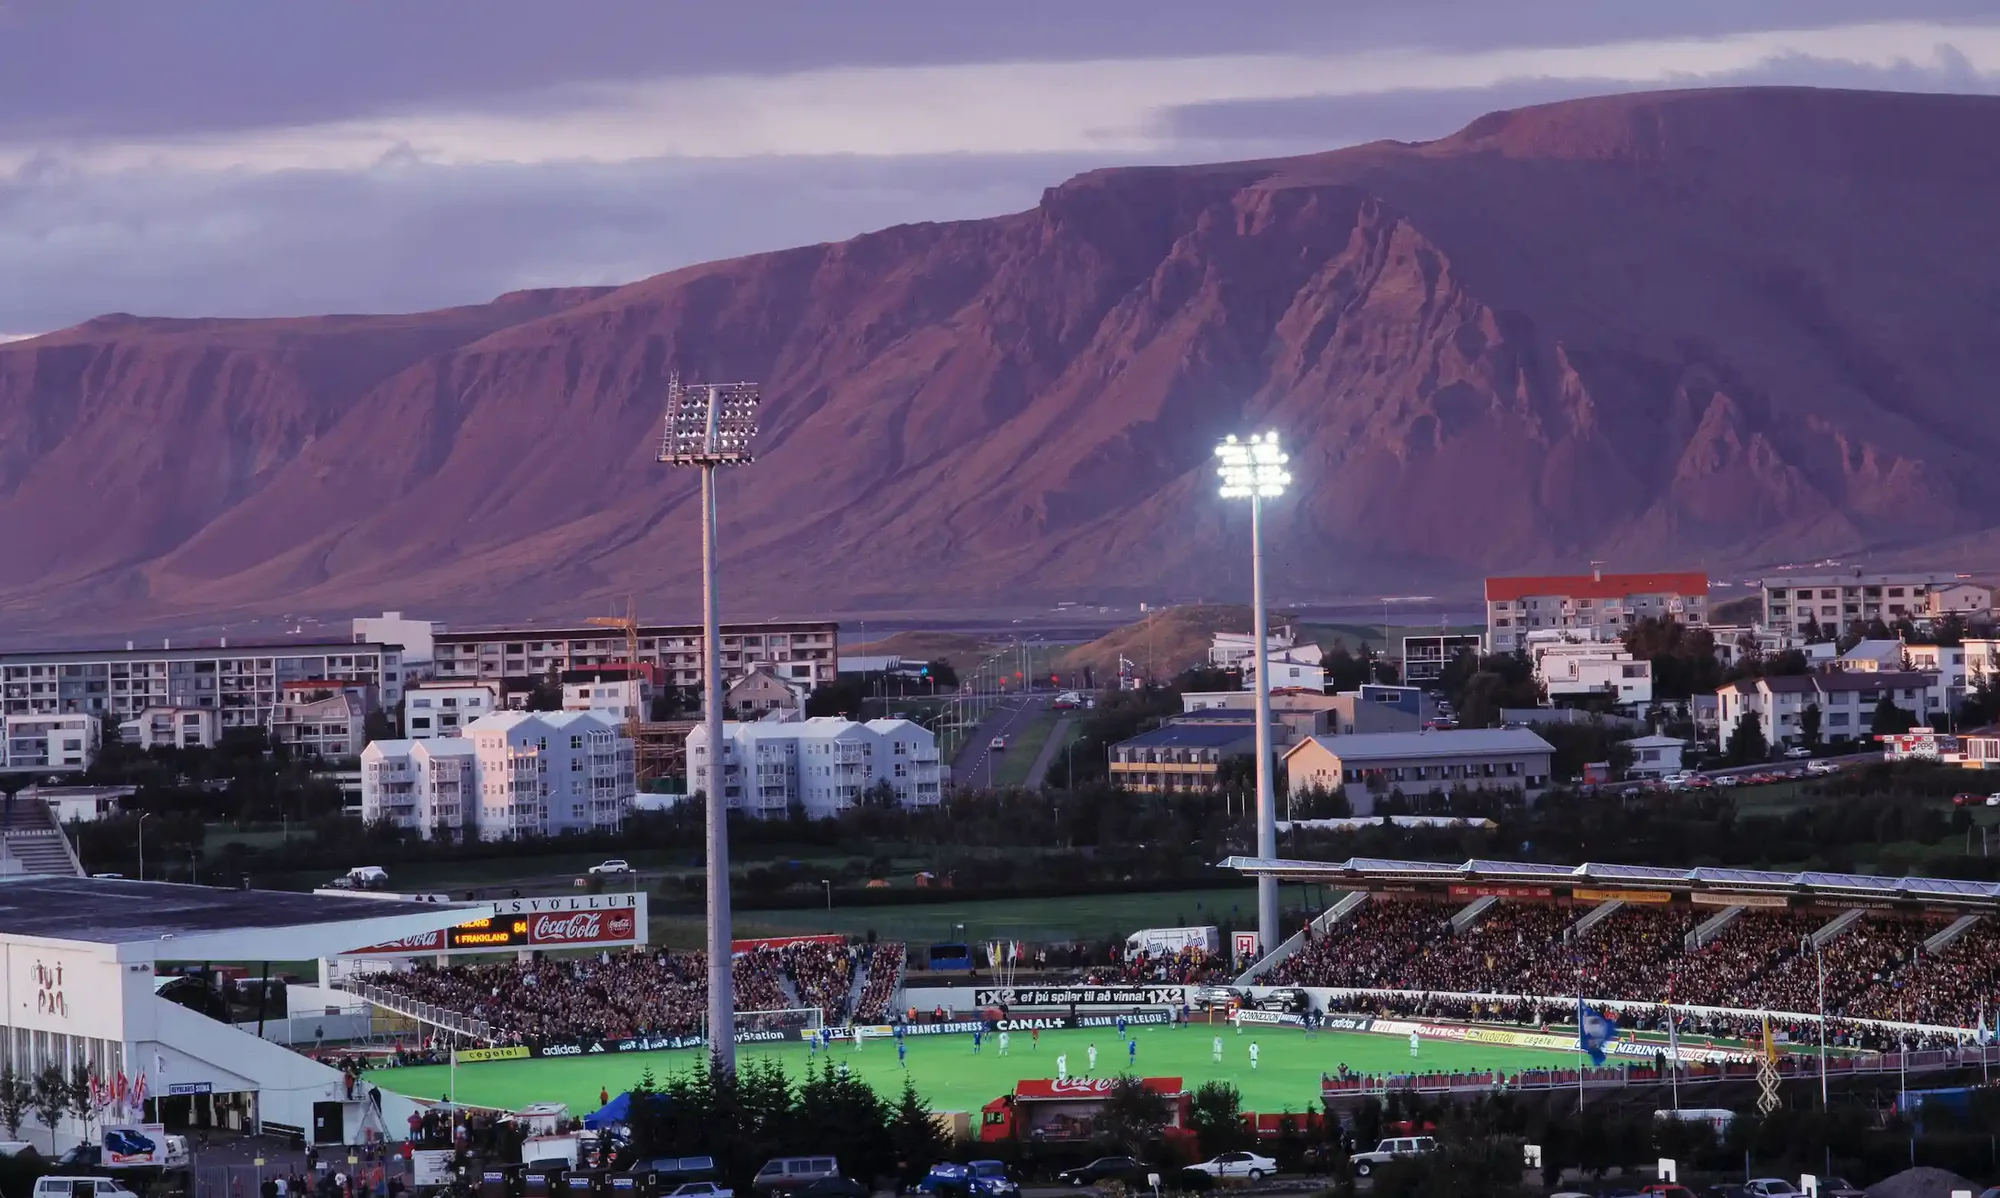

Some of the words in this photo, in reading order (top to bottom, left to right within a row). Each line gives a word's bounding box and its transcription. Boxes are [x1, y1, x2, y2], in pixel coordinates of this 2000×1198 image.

[1917, 742, 1934, 750] PEPSI
[513, 921, 527, 933] 84
[534, 913, 602, 941] Coca-Cola
[461, 933, 509, 945] FRAKKLAND
[977, 989, 1017, 1006] 1X2
[1020, 991, 1033, 1003] ef
[1034, 989, 1050, 1005] þú
[1051, 989, 1082, 1005] spilar
[1084, 989, 1095, 1001] til
[1096, 989, 1111, 1001] að
[1113, 989, 1146, 1001] vinna!
[1147, 988, 1184, 1004] 1X2
[996, 1017, 1065, 1031] CANAL+
[1084, 1016, 1112, 1026] ALAIN
[1115, 1013, 1162, 1026] FLELOU
[1331, 1019, 1357, 1030] adidas
[907, 1024, 941, 1035] FRANCE
[944, 1021, 983, 1033] EXPRESS
[1478, 1031, 1514, 1043] KILOUTOU
[1523, 1036, 1556, 1047] cegetel
[469, 1048, 518, 1059] cegetel
[542, 1043, 582, 1056] adidas
[1616, 1042, 1670, 1057] MERINOS
